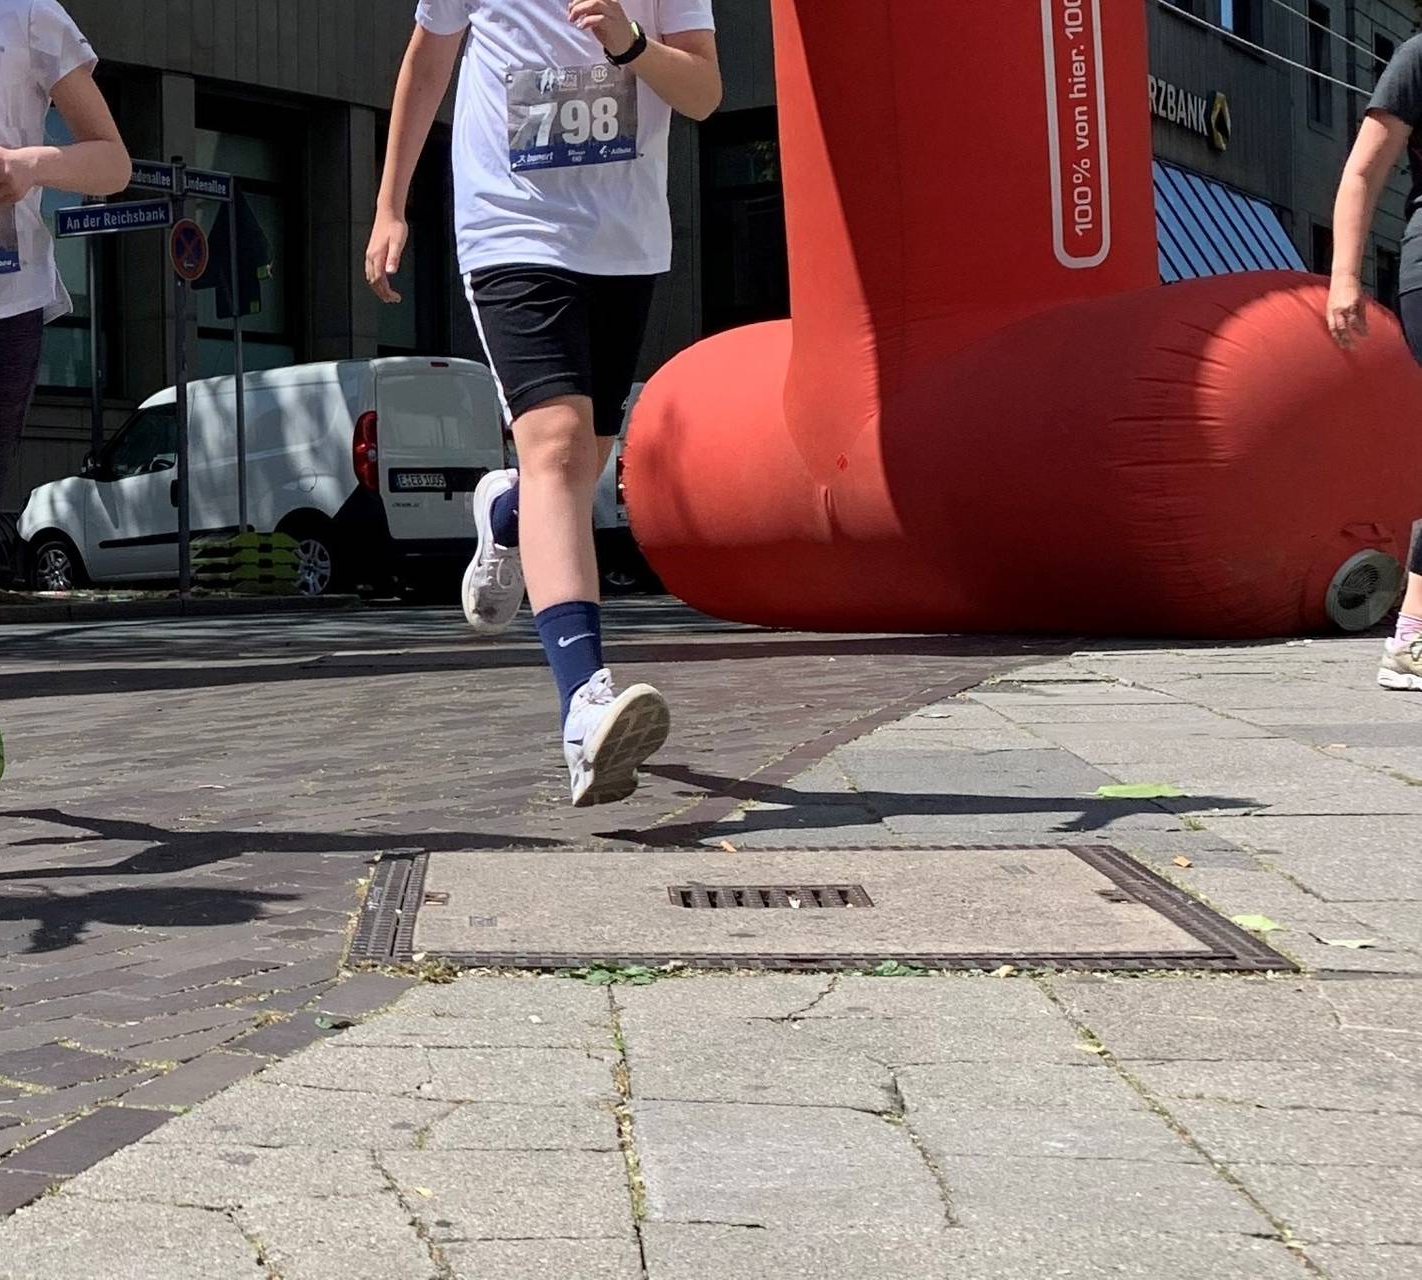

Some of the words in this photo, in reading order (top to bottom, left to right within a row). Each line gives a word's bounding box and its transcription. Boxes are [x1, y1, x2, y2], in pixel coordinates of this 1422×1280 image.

[1068, 44, 1087, 99] hier.
[529, 97, 619, 147] 798
[1075, 105, 1089, 151] von
[184, 175, 227, 195] Lindenallee
[66, 216, 80, 230] An
[83, 214, 100, 229] der
[104, 207, 166, 226] Reichsbank
